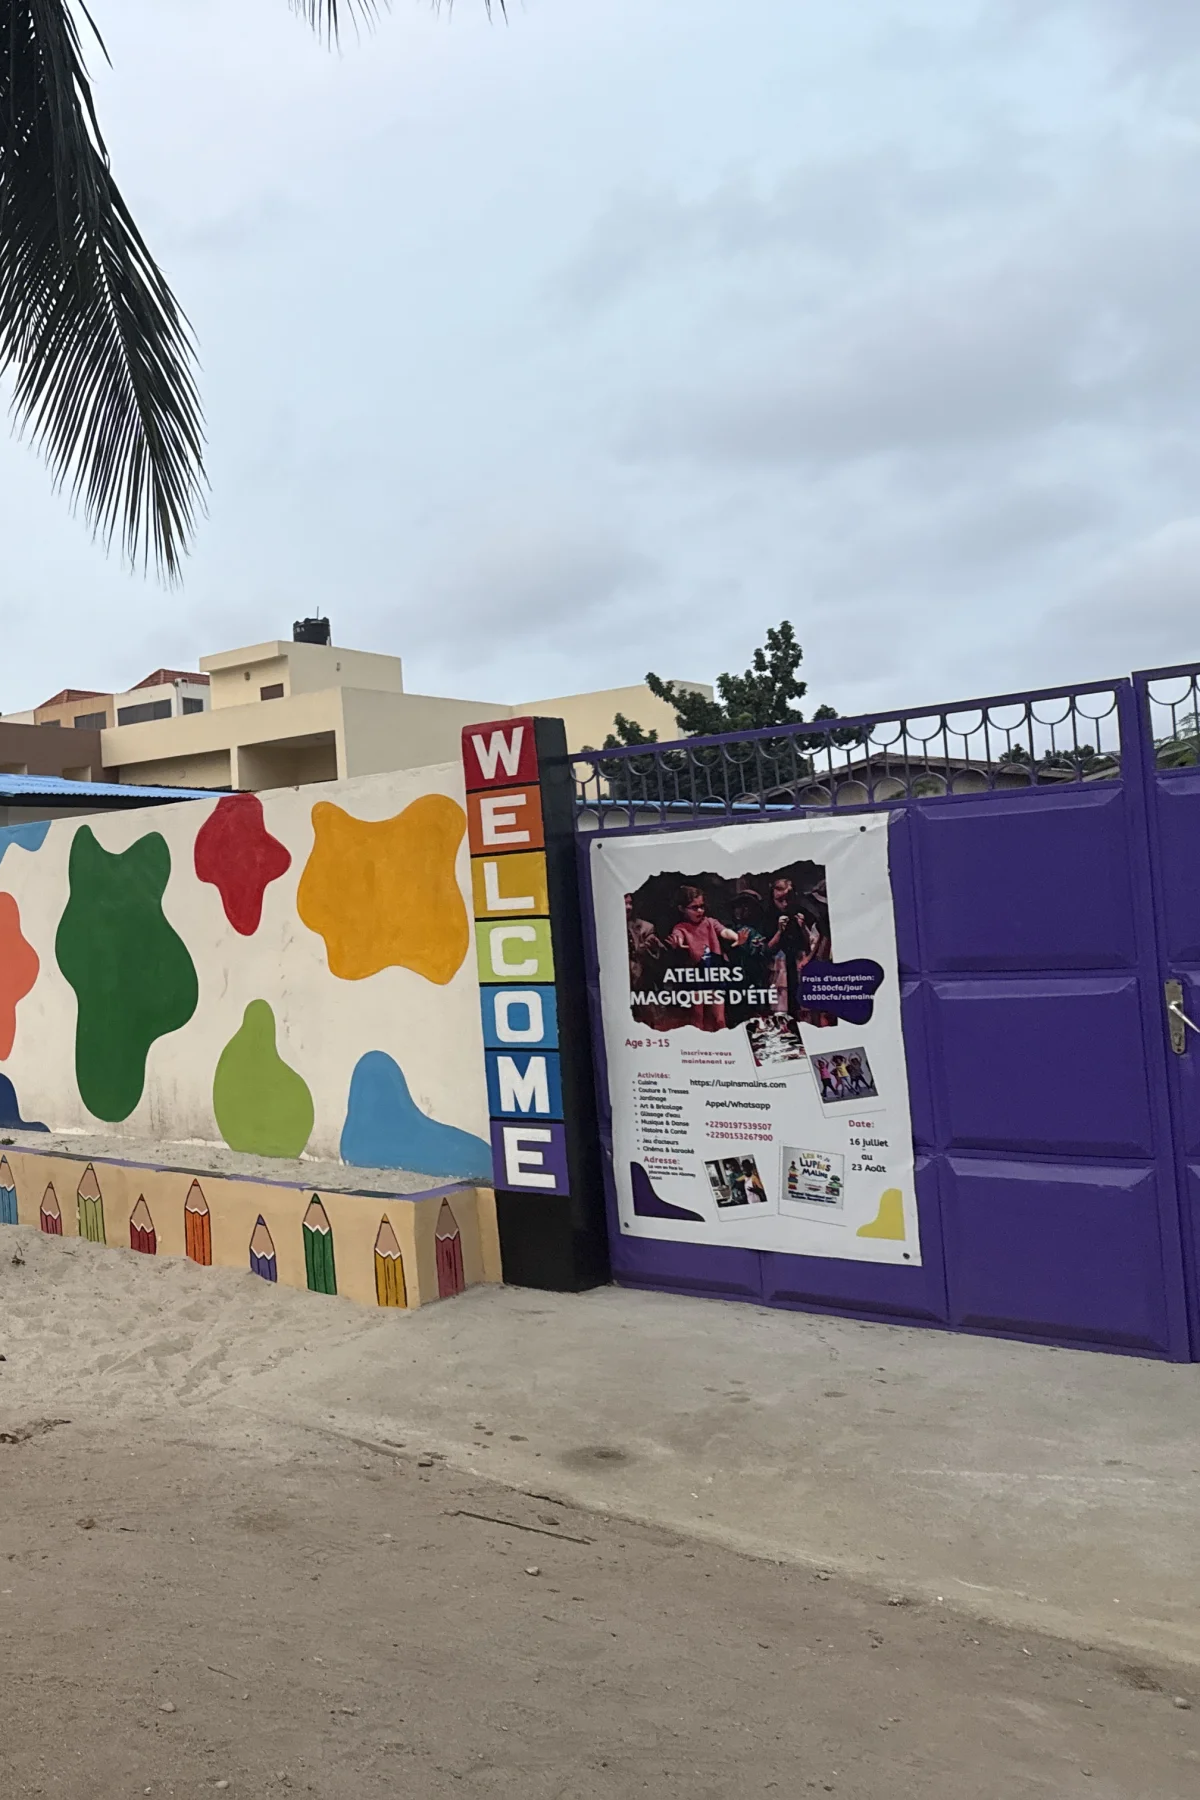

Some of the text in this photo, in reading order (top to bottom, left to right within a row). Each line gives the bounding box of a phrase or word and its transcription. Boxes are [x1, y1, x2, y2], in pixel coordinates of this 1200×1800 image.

[471, 726, 556, 1189] WELCOME
[663, 966, 743, 983] ATELIERS
[630, 984, 779, 1008] MAGIQUES D'ÉTÉ
[625, 1038, 670, 1049] Age 3-15
[848, 1119, 875, 1128] Date:
[849, 1138, 861, 1146] 16
[851, 1163, 863, 1171] 23
